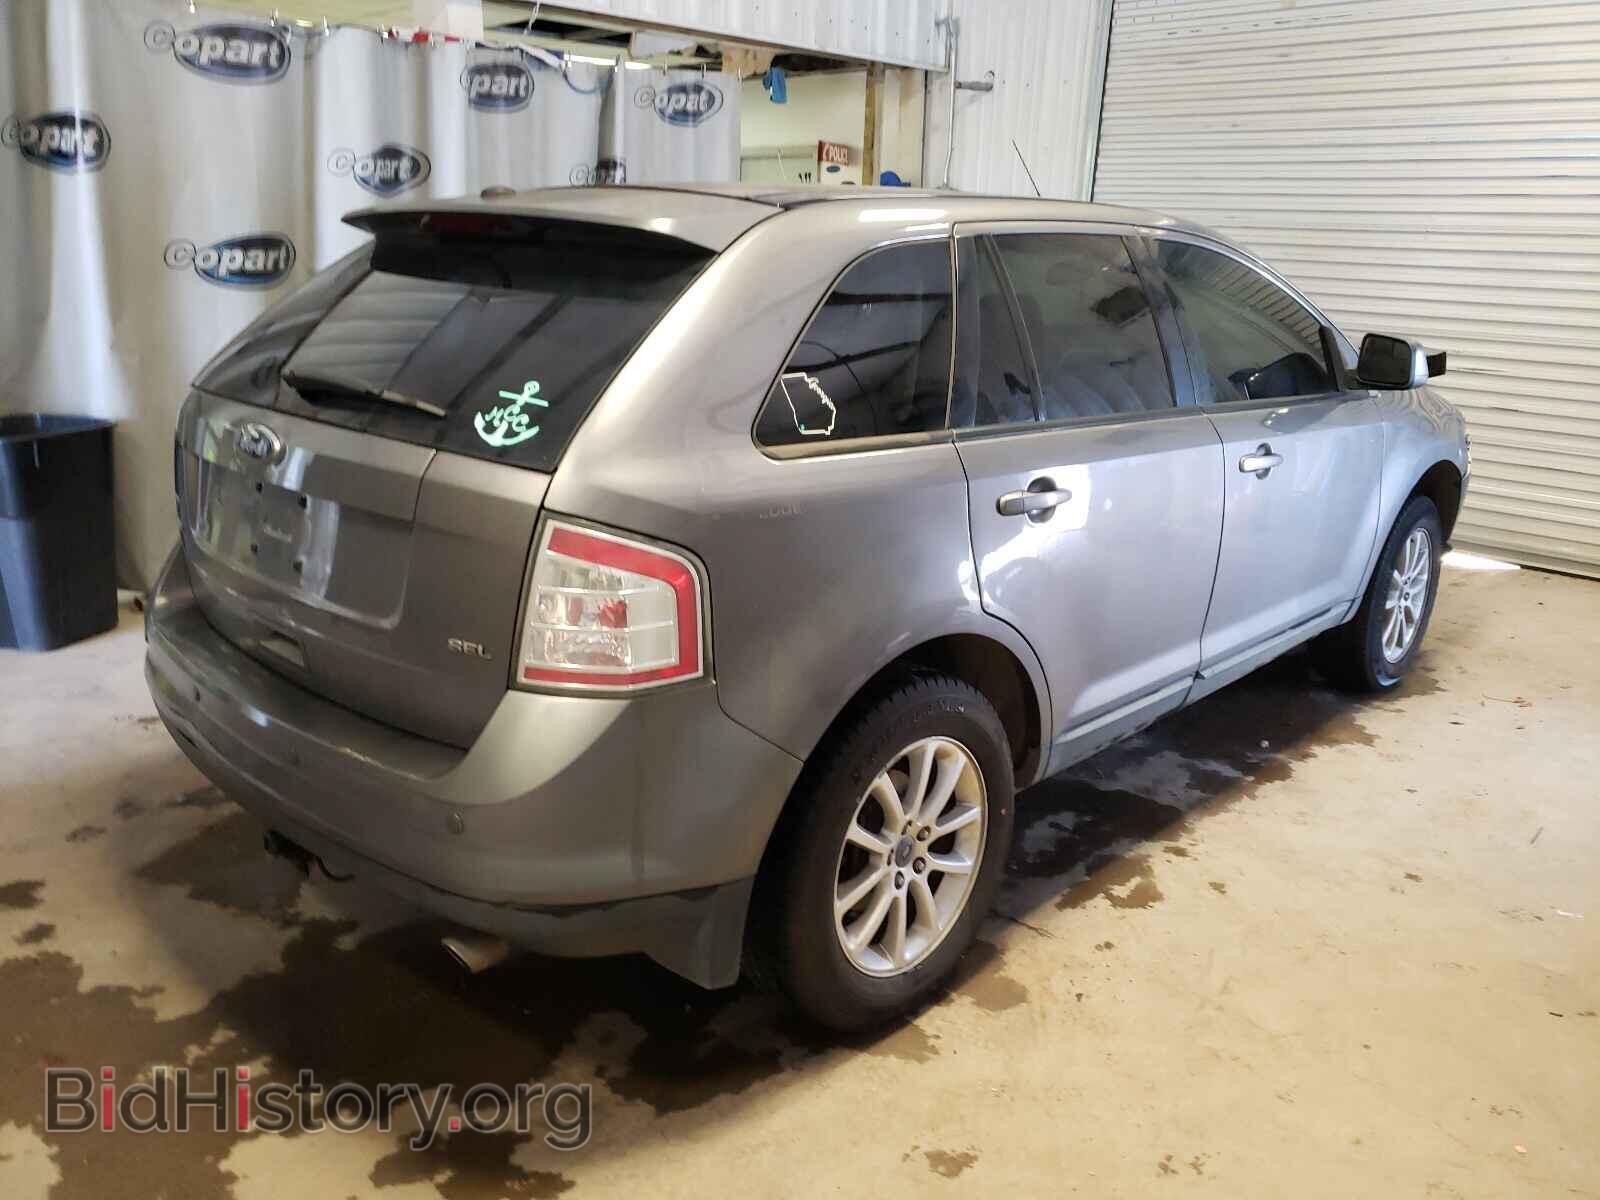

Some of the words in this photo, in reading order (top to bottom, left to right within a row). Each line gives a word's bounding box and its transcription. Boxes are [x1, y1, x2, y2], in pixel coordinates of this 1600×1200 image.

[146, 21, 283, 67] Copart
[463, 72, 527, 99] part
[165, 240, 288, 277] Copart
